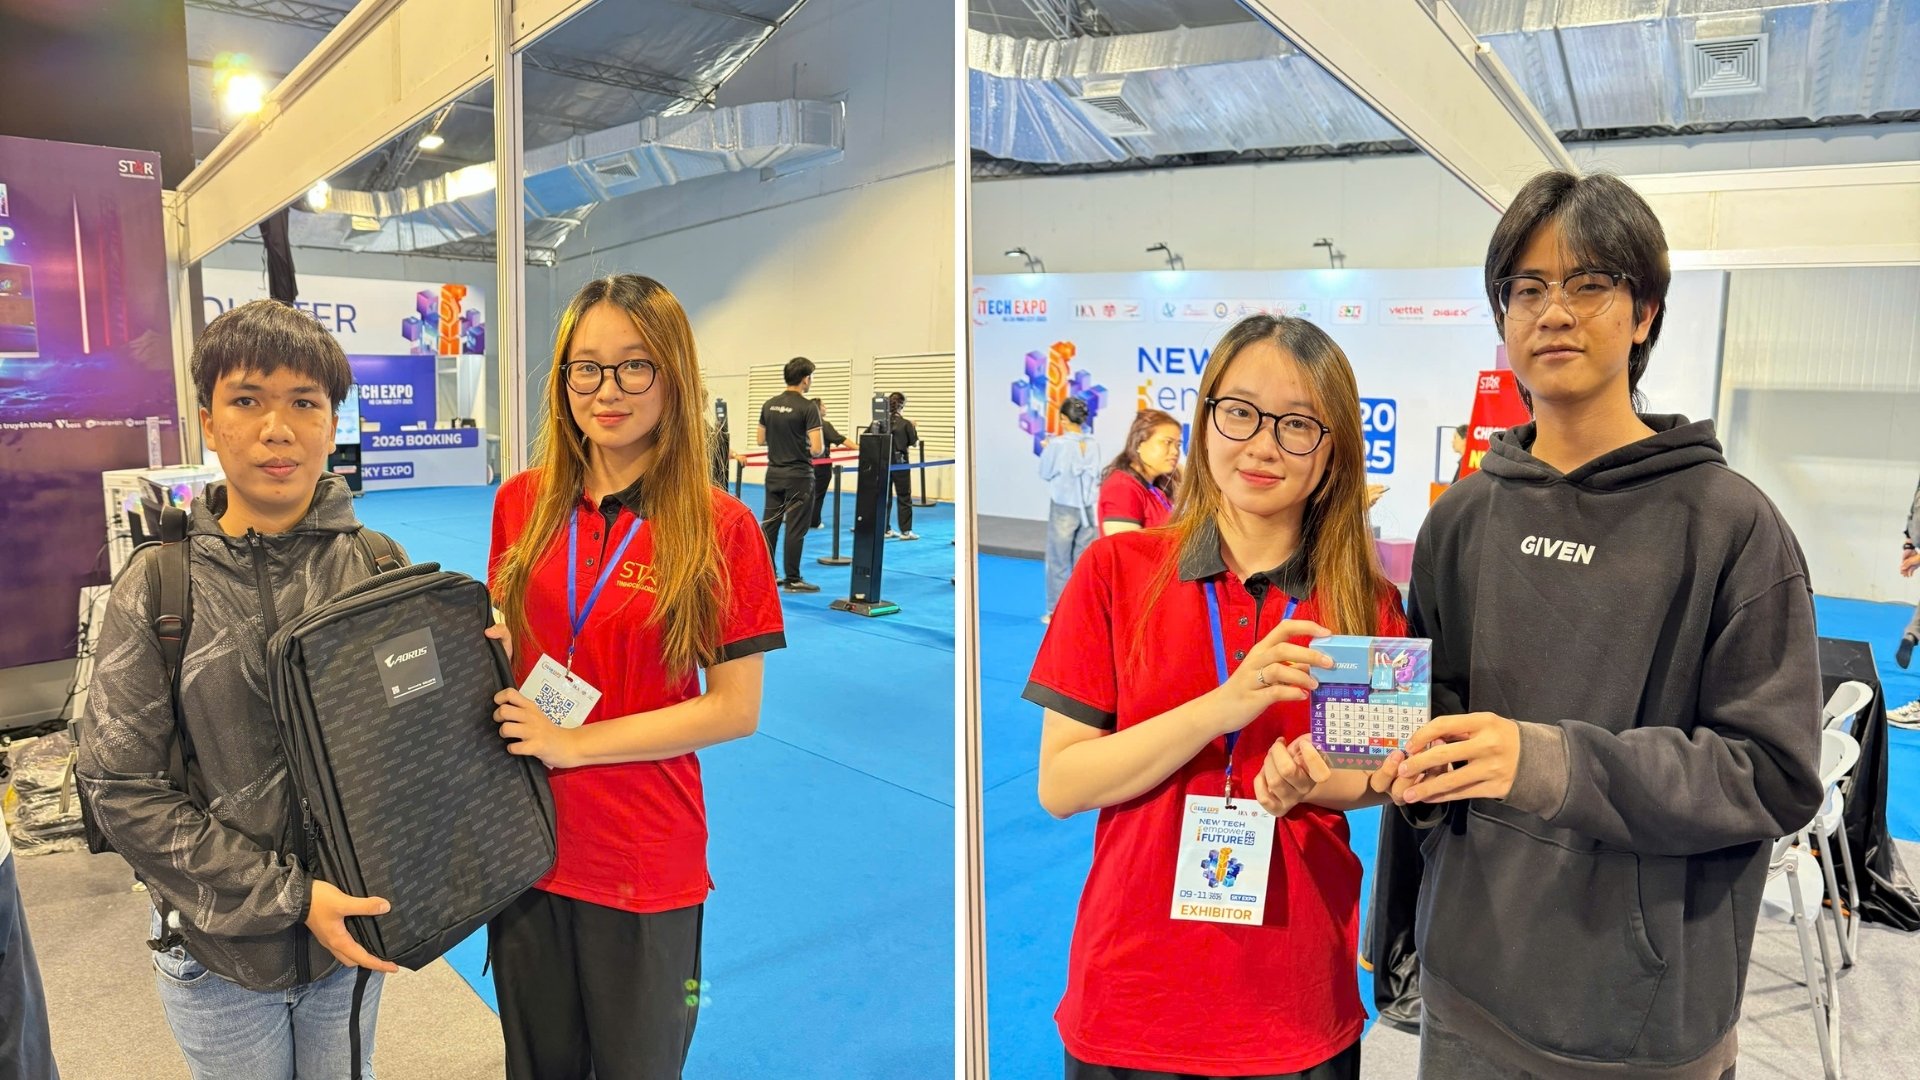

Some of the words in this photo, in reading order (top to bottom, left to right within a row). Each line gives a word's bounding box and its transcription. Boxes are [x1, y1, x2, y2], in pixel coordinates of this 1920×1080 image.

[1014, 298, 1047, 315] EXPO
[1137, 346, 1211, 375] NEW
[381, 384, 414, 399] EXPO
[1360, 401, 1395, 433] 20
[372, 435, 404, 448] 2026
[405, 433, 462, 447] BOOKING
[382, 465, 412, 476] EXPO
[1520, 535, 1596, 565] GIVEN
[394, 646, 428, 665] AORUS
[1334, 662, 1359, 670] ORUS
[1199, 818, 1220, 826] NEW
[1222, 820, 1246, 828] TECH
[1203, 826, 1245, 836] empower
[1201, 833, 1244, 845] FUTURE
[1180, 889, 1193, 898] 09
[1197, 890, 1207, 899] 11
[1180, 904, 1253, 921] EXHIBITOR
